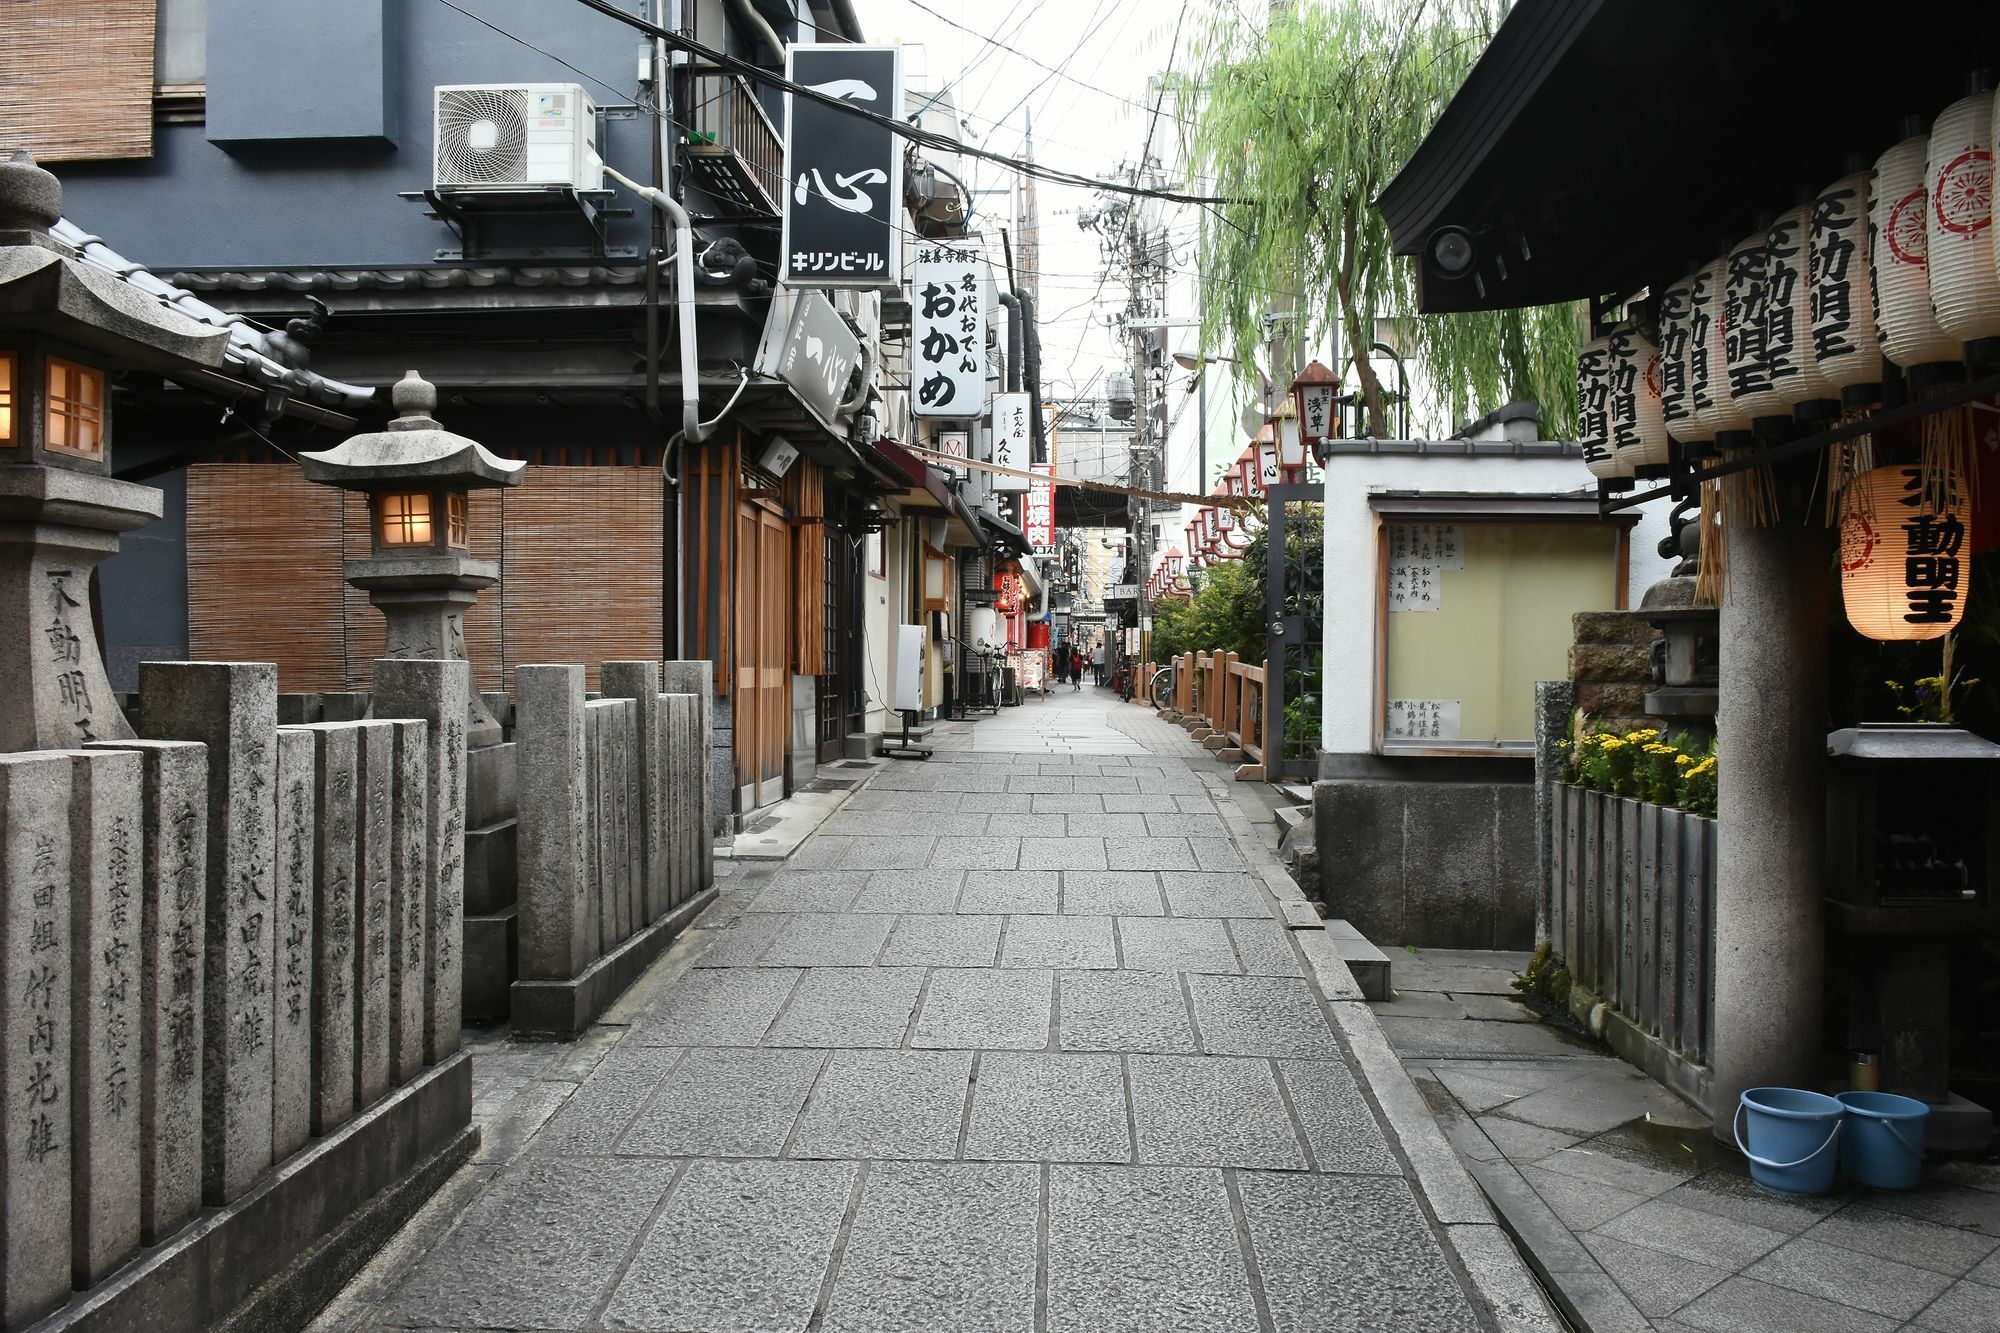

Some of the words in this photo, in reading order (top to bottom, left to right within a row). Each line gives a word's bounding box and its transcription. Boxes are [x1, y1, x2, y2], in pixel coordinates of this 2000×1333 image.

[795, 79, 888, 213] 一心
[792, 252, 884, 271] キリンビール
[918, 281, 959, 408] おかめ
[959, 273, 977, 374] 名代おでん
[1422, 567, 1431, 602] おかめ
[1899, 468, 1965, 624] 不動明王
